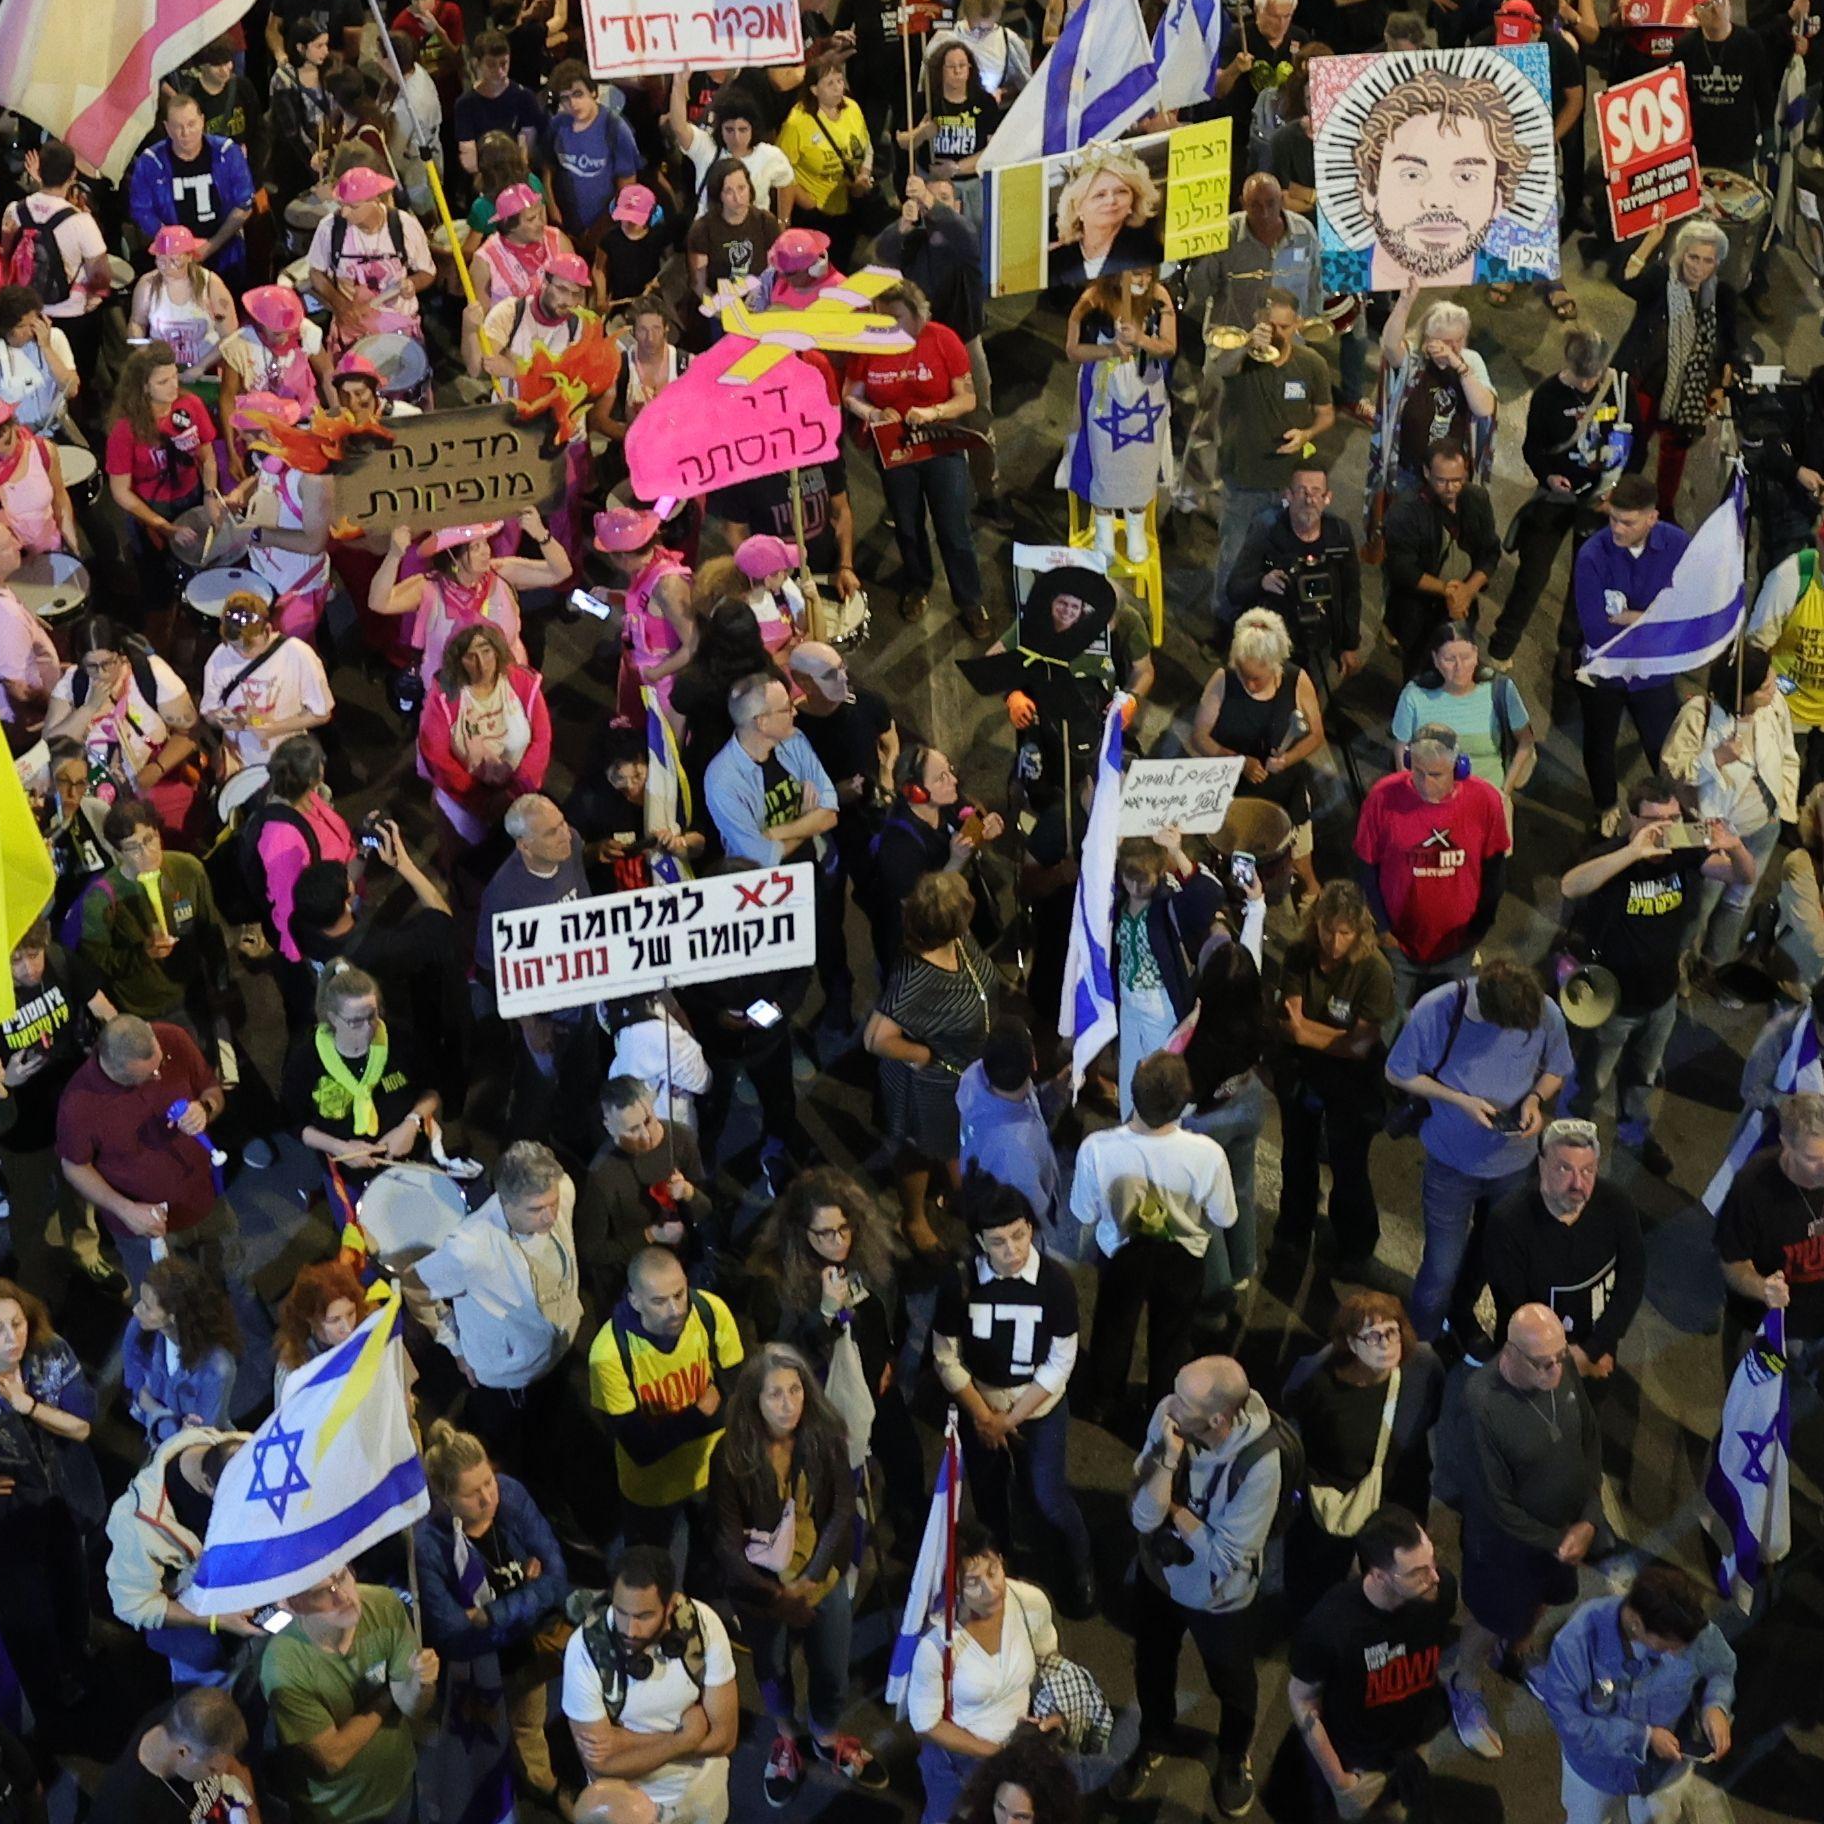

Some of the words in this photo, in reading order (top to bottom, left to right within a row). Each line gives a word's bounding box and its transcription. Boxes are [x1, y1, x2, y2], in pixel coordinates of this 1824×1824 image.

[599, 13, 680, 54] יהודי
[691, 1, 788, 52] מפקיר
[1605, 75, 1687, 166] SOS
[1172, 138, 1229, 176] הצדק
[1179, 174, 1229, 205] איתך
[1176, 202, 1225, 232] כולנו
[1180, 231, 1225, 256] איתך
[741, 384, 789, 414] די
[387, 429, 521, 471] מדינה
[676, 412, 828, 488] להסתה
[355, 471, 535, 520] מופקרת
[733, 871, 795, 913] לא
[497, 916, 540, 954] על
[560, 886, 705, 944] למלחמה
[628, 934, 673, 971] של
[687, 911, 796, 963] תקומה
[500, 945, 610, 996] נתניהו!
[1365, 1645, 1441, 1704] NOW!
